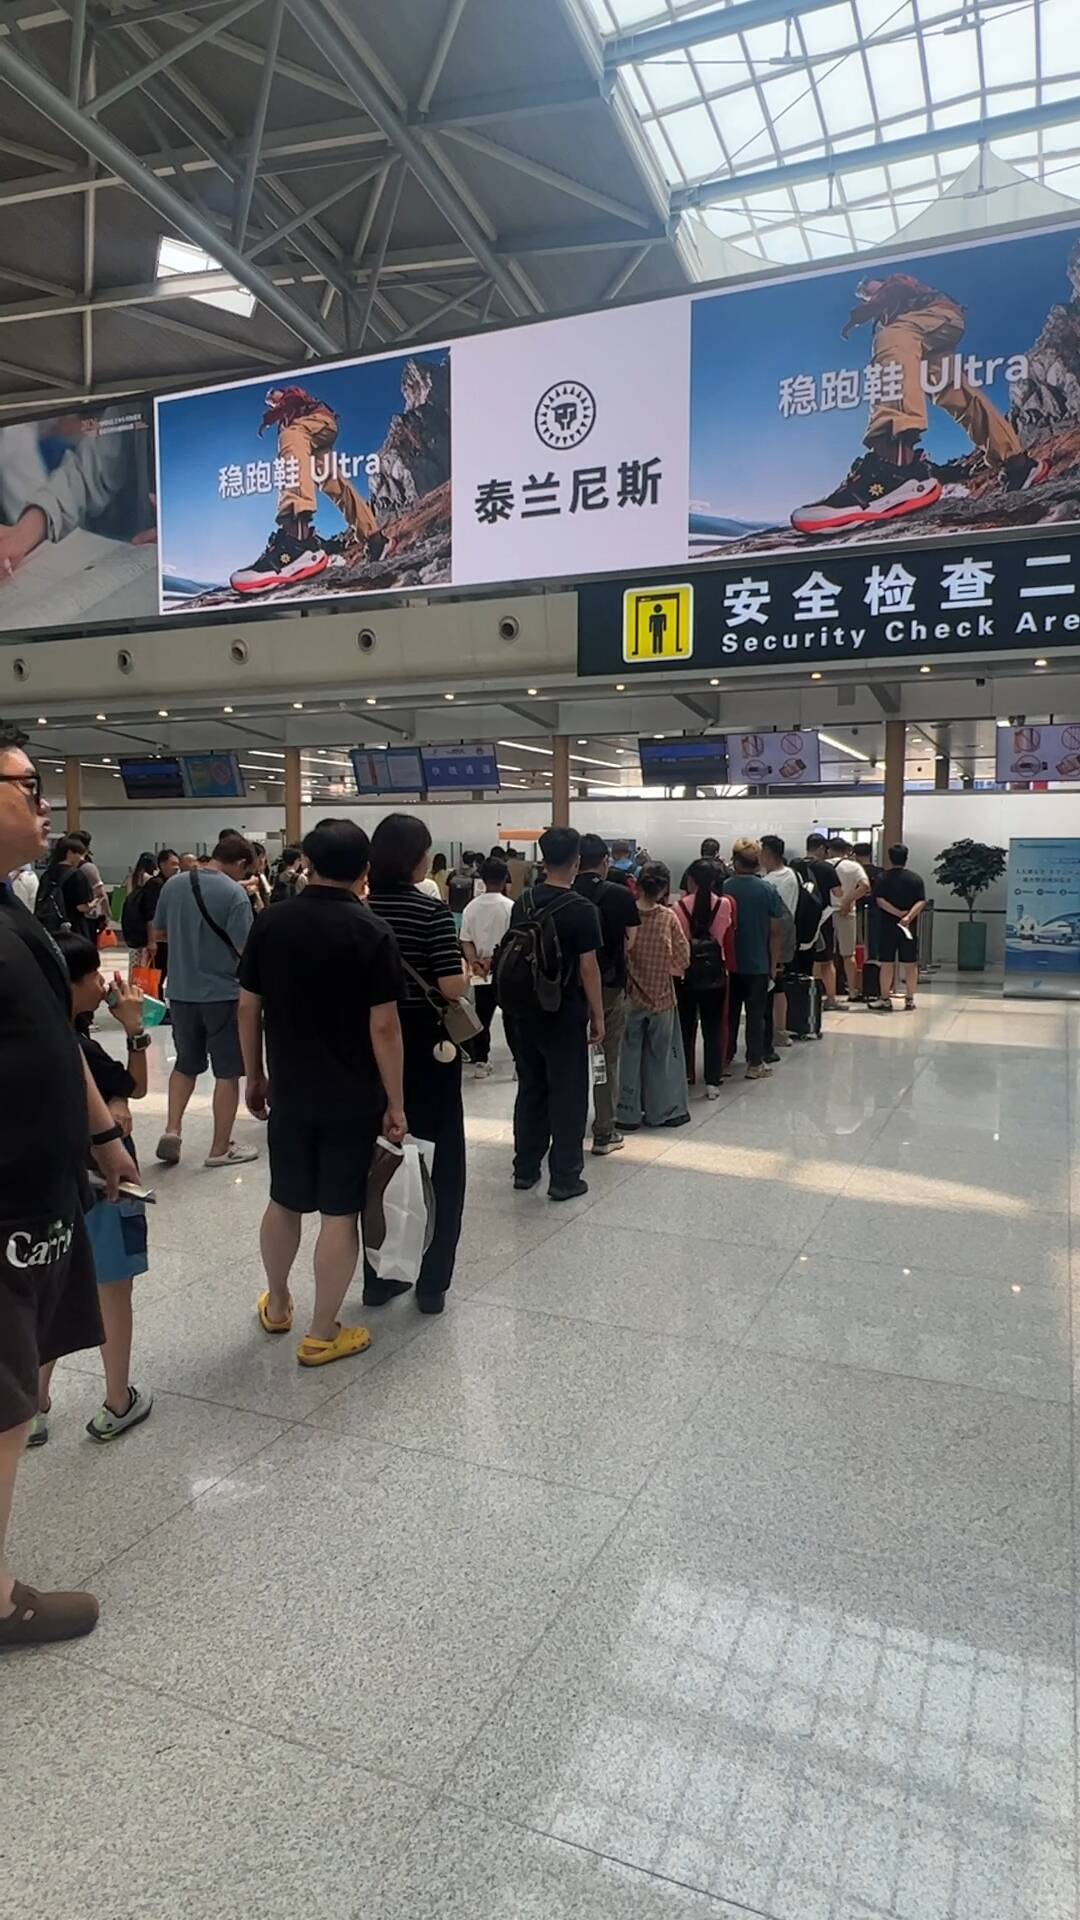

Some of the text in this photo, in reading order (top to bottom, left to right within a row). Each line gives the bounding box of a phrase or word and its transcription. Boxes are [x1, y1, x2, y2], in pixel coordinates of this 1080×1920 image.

[777, 353, 1029, 418] 稳跑鞋 Ultra
[218, 451, 380, 499] 稳跑鞋 Ultra
[474, 456, 663, 525] 泰兰尼斯
[723, 554, 1076, 628] 安全检查二
[722, 626, 867, 654] Security
[885, 615, 995, 643] Check
